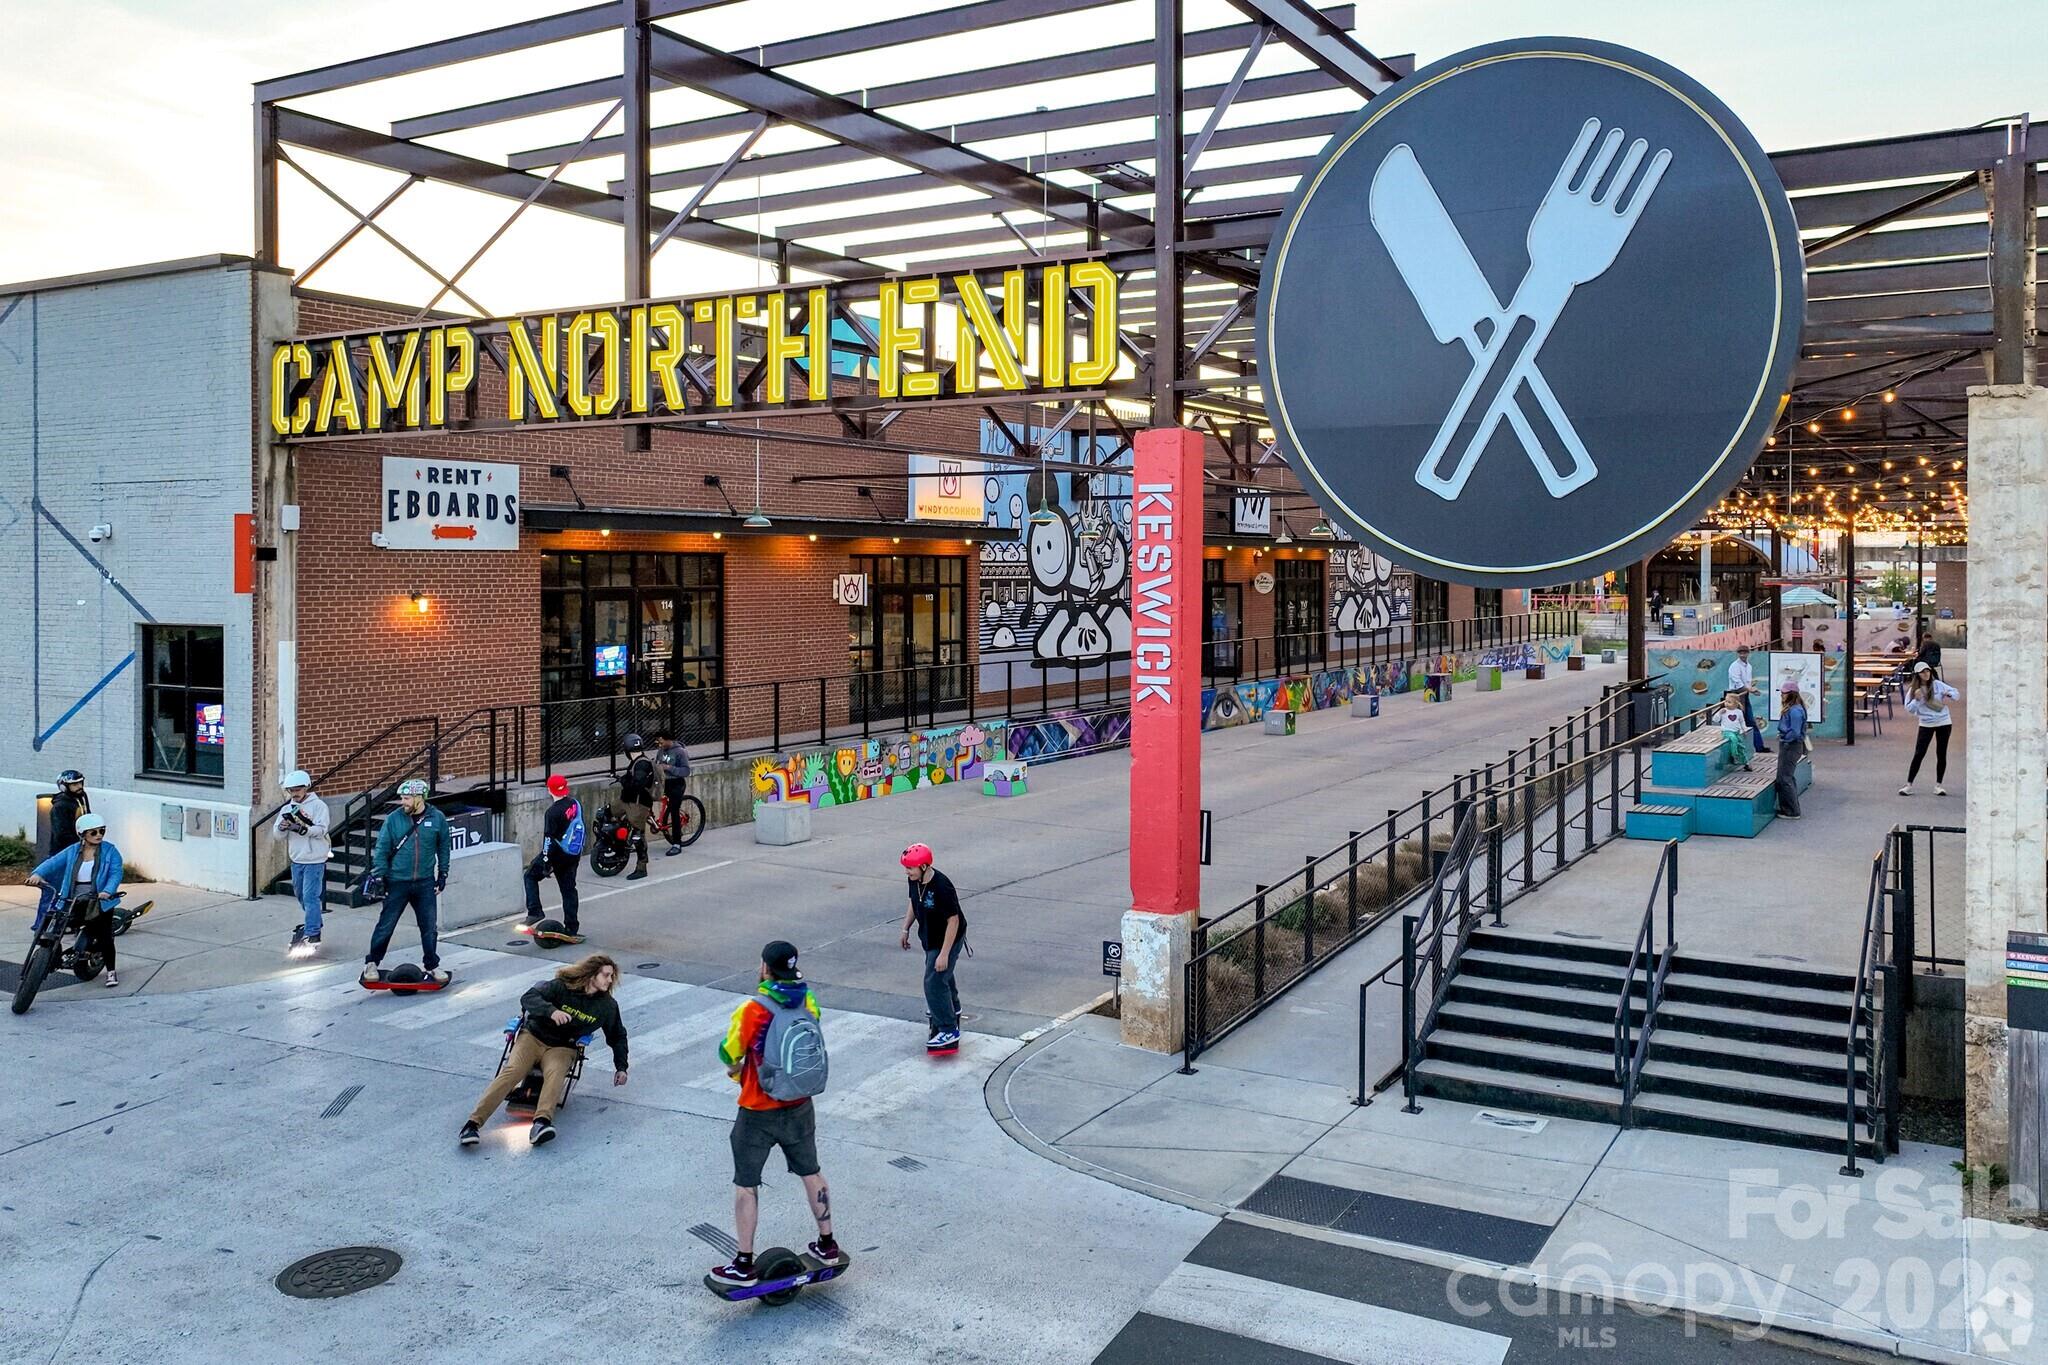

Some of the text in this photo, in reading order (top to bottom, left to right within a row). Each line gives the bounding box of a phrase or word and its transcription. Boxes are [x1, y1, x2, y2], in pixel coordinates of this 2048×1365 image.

[272, 261, 1120, 435] CAMP NORTH END
[427, 467, 482, 485] RENT
[388, 489, 517, 525] EBOARDS
[919, 505, 942, 515] WINDY
[661, 600, 673, 610] 114
[1136, 483, 1173, 704] KESWICK
